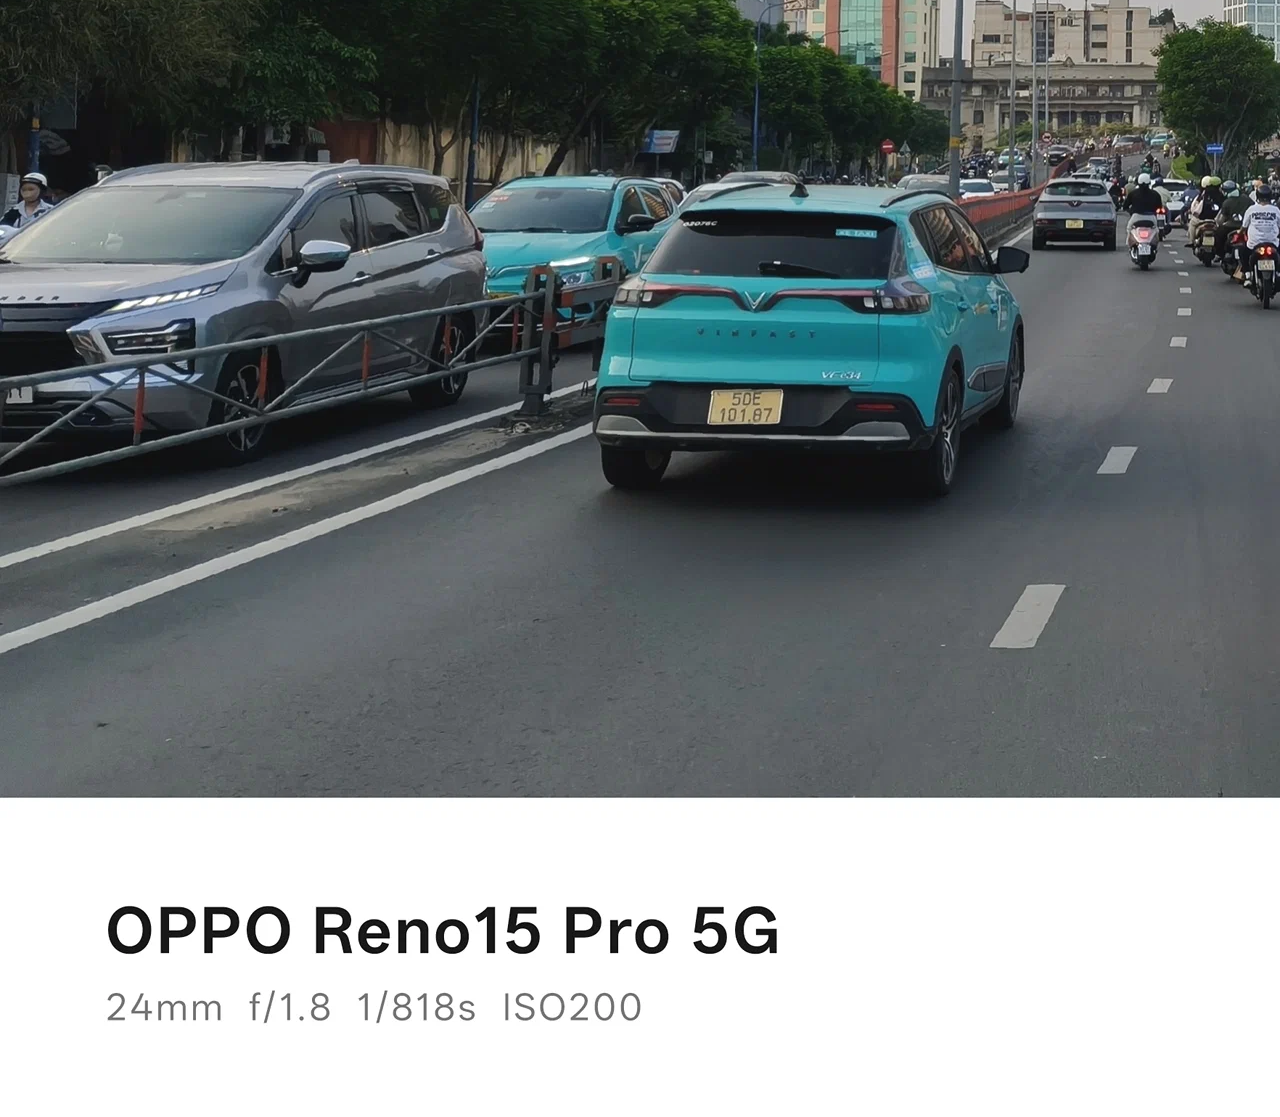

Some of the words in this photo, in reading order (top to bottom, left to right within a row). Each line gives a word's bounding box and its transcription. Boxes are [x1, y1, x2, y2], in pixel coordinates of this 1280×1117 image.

[696, 327, 817, 339] VINFAST
[731, 392, 762, 406] 50E
[720, 407, 773, 423] 101.87
